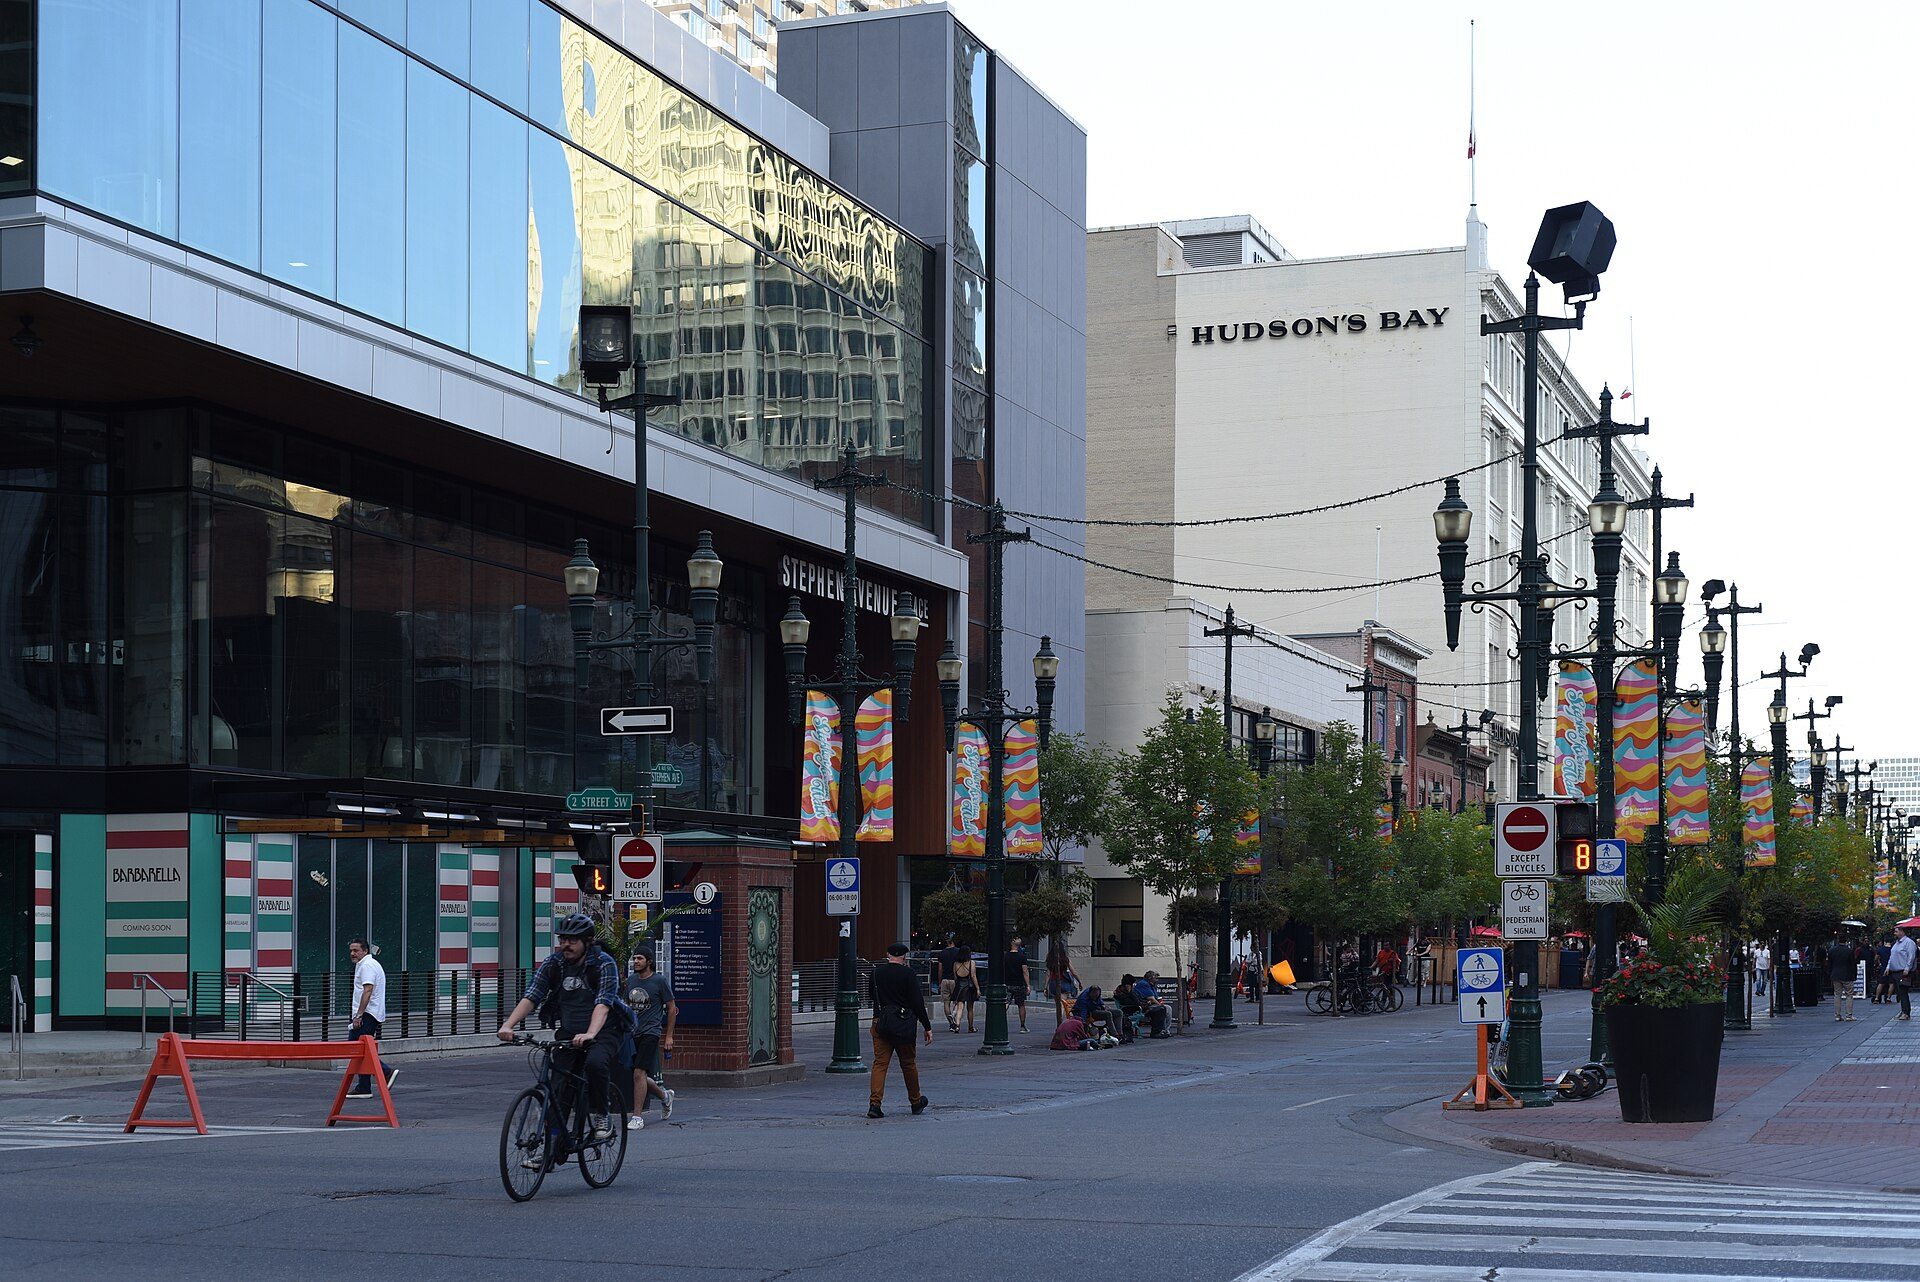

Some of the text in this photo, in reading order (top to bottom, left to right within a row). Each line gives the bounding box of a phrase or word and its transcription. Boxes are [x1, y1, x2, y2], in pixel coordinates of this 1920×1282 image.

[1191, 307, 1450, 344] HUDSON'S BAY
[782, 554, 845, 602] STEPHEN
[854, 578, 899, 617] VENUE
[1566, 689, 1588, 743] Stephen
[652, 772, 681, 783] STEPHEN AVE
[571, 796, 628, 808] 2 STREET SW
[1510, 854, 1540, 863] EXCEPT
[1576, 843, 1590, 870] 8
[1505, 864, 1546, 873] BICYCLES
[113, 867, 181, 883] BARBARELLA
[625, 881, 650, 889] EXCEPT
[620, 890, 655, 898] BICYCLES
[258, 900, 291, 911] BARBARELLA
[696, 907, 712, 915] Core
[122, 923, 172, 932] COMING SOON
[1513, 927, 1537, 935] SIGNAL
